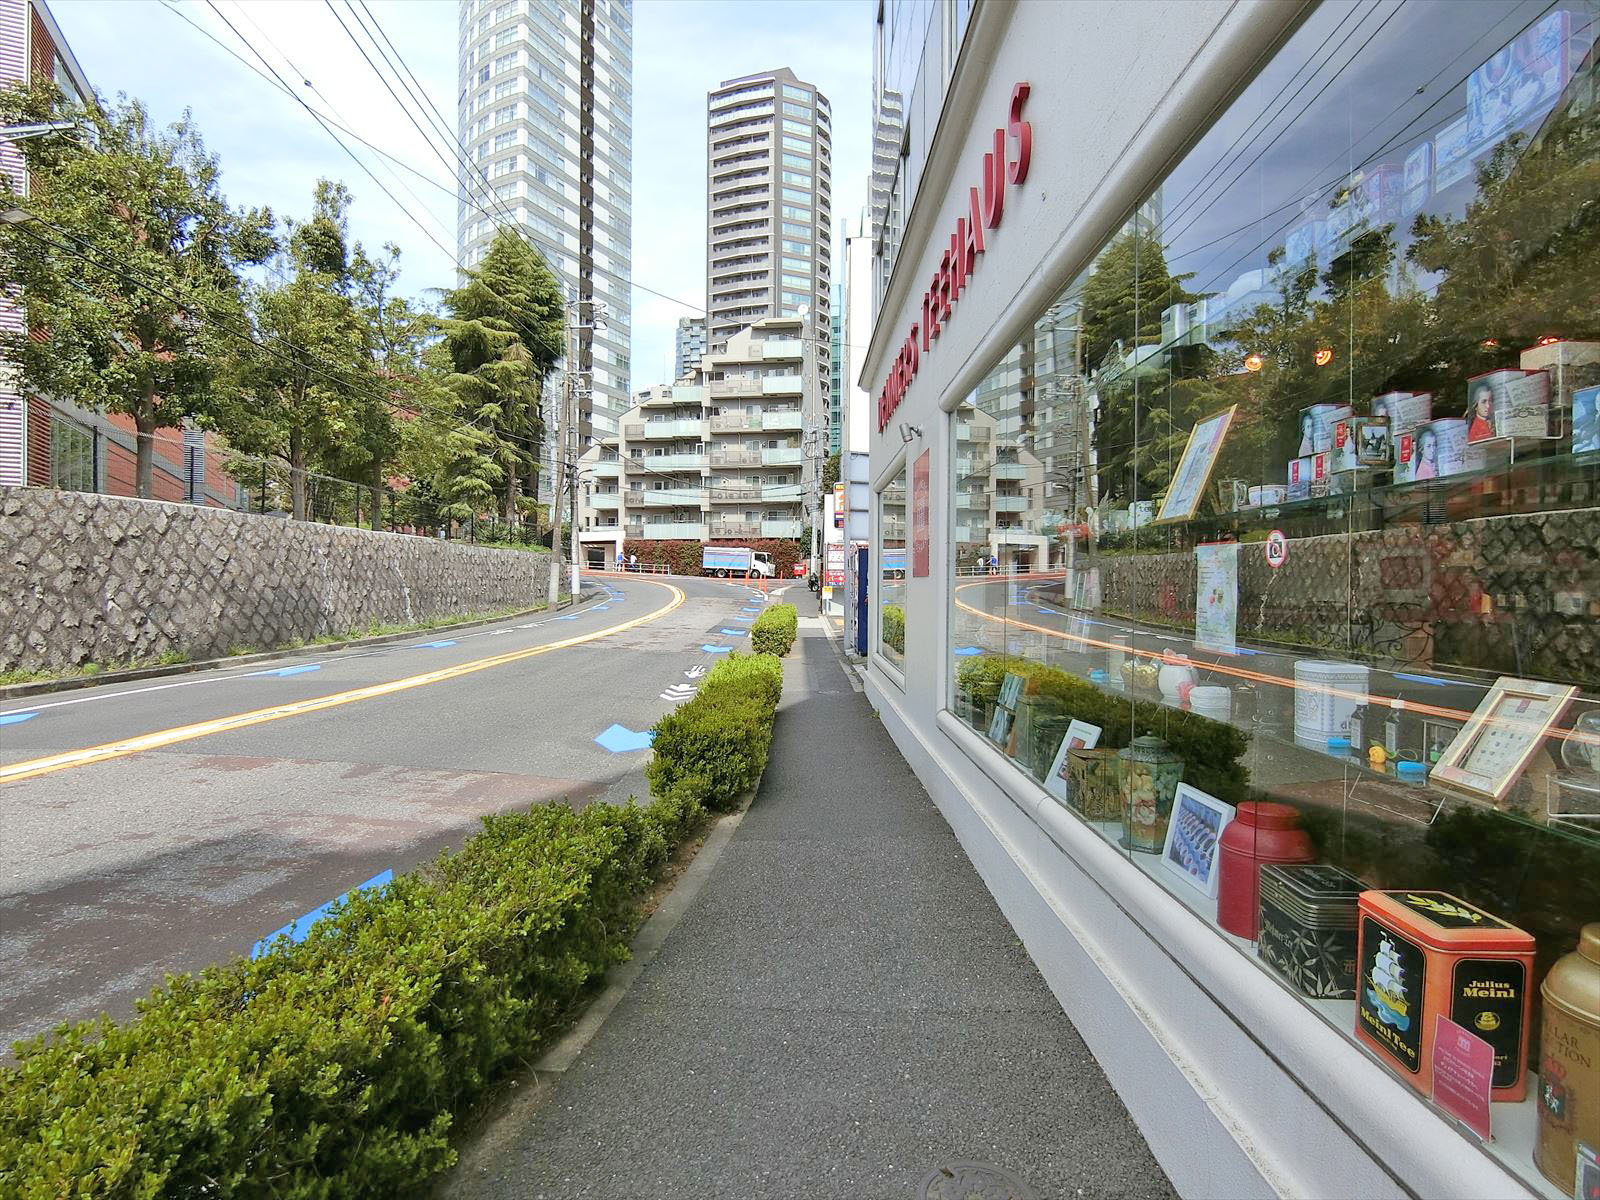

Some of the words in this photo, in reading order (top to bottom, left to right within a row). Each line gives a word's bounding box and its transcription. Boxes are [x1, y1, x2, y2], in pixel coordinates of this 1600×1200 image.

[922, 81, 1033, 352] TEEHAUS
[1462, 987, 1515, 998] Meinl
[1468, 980, 1510, 989] Julius
[1360, 1006, 1392, 1039] Meinl
[1392, 1032, 1416, 1058] Tee
